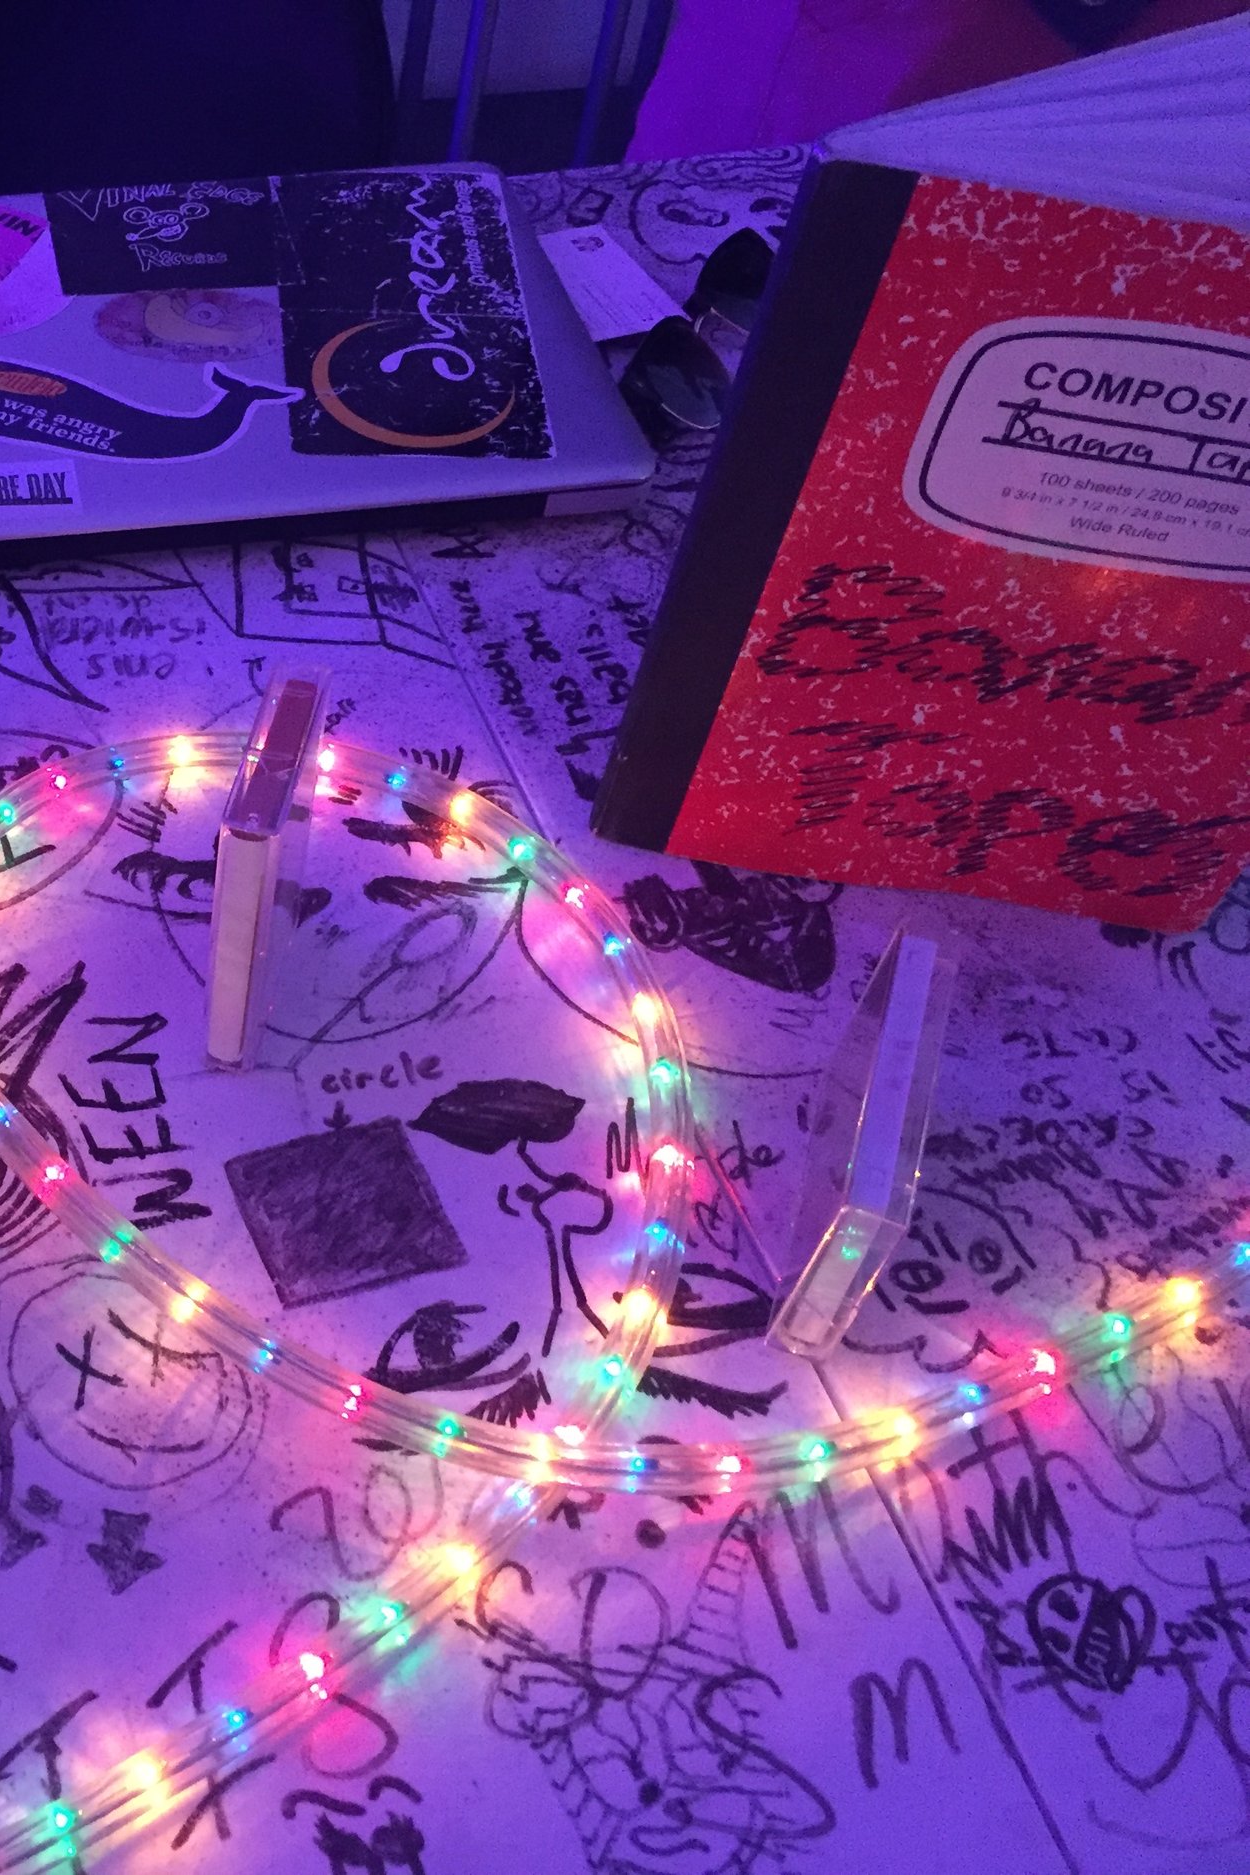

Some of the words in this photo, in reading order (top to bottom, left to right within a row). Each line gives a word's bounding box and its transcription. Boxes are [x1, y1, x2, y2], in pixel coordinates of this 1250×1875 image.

[379, 172, 476, 382] dream
[3, 399, 48, 420] was
[53, 413, 123, 440] angry
[27, 416, 116, 453] friends.
[27, 471, 67, 500] DAY
[1041, 471, 1072, 488] 100
[1074, 478, 1133, 499] sheets
[1148, 489, 1183, 506] 200
[1183, 496, 1241, 517] pages
[1070, 516, 1113, 535] Wide
[1117, 524, 1171, 545] Ruled
[321, 1051, 444, 1094] circle
